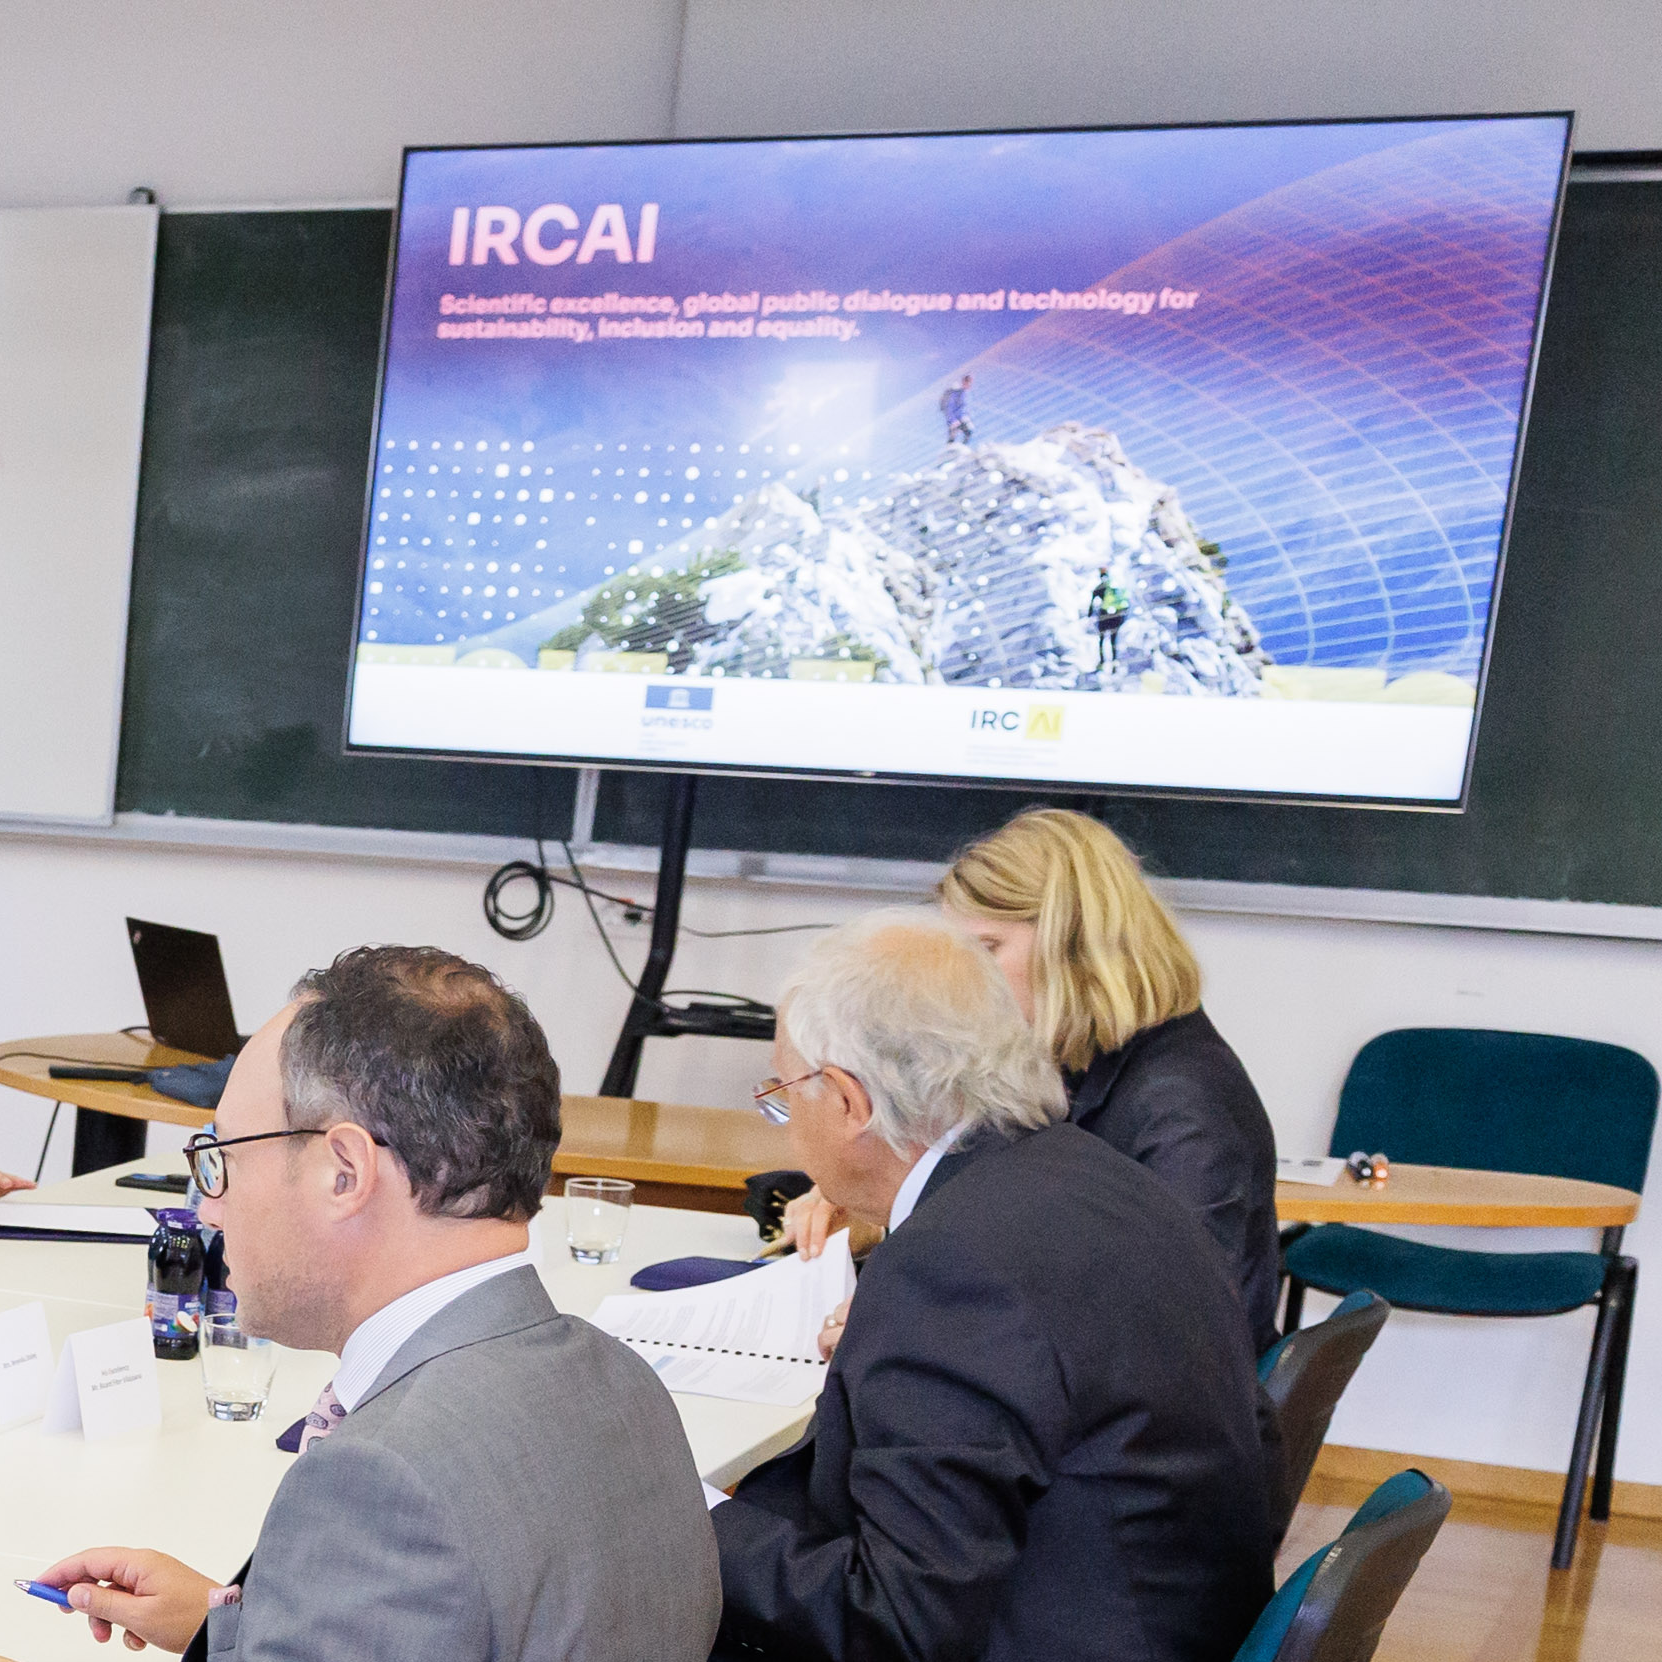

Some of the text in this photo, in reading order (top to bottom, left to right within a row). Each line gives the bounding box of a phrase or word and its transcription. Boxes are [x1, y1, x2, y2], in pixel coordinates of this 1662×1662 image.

[448, 202, 660, 267] IRCAI
[439, 286, 1199, 318] Scientific excellence, global public dialogue and technology for
[436, 314, 861, 343] sustainability, inclusion and equality.
[641, 716, 714, 729] unesco
